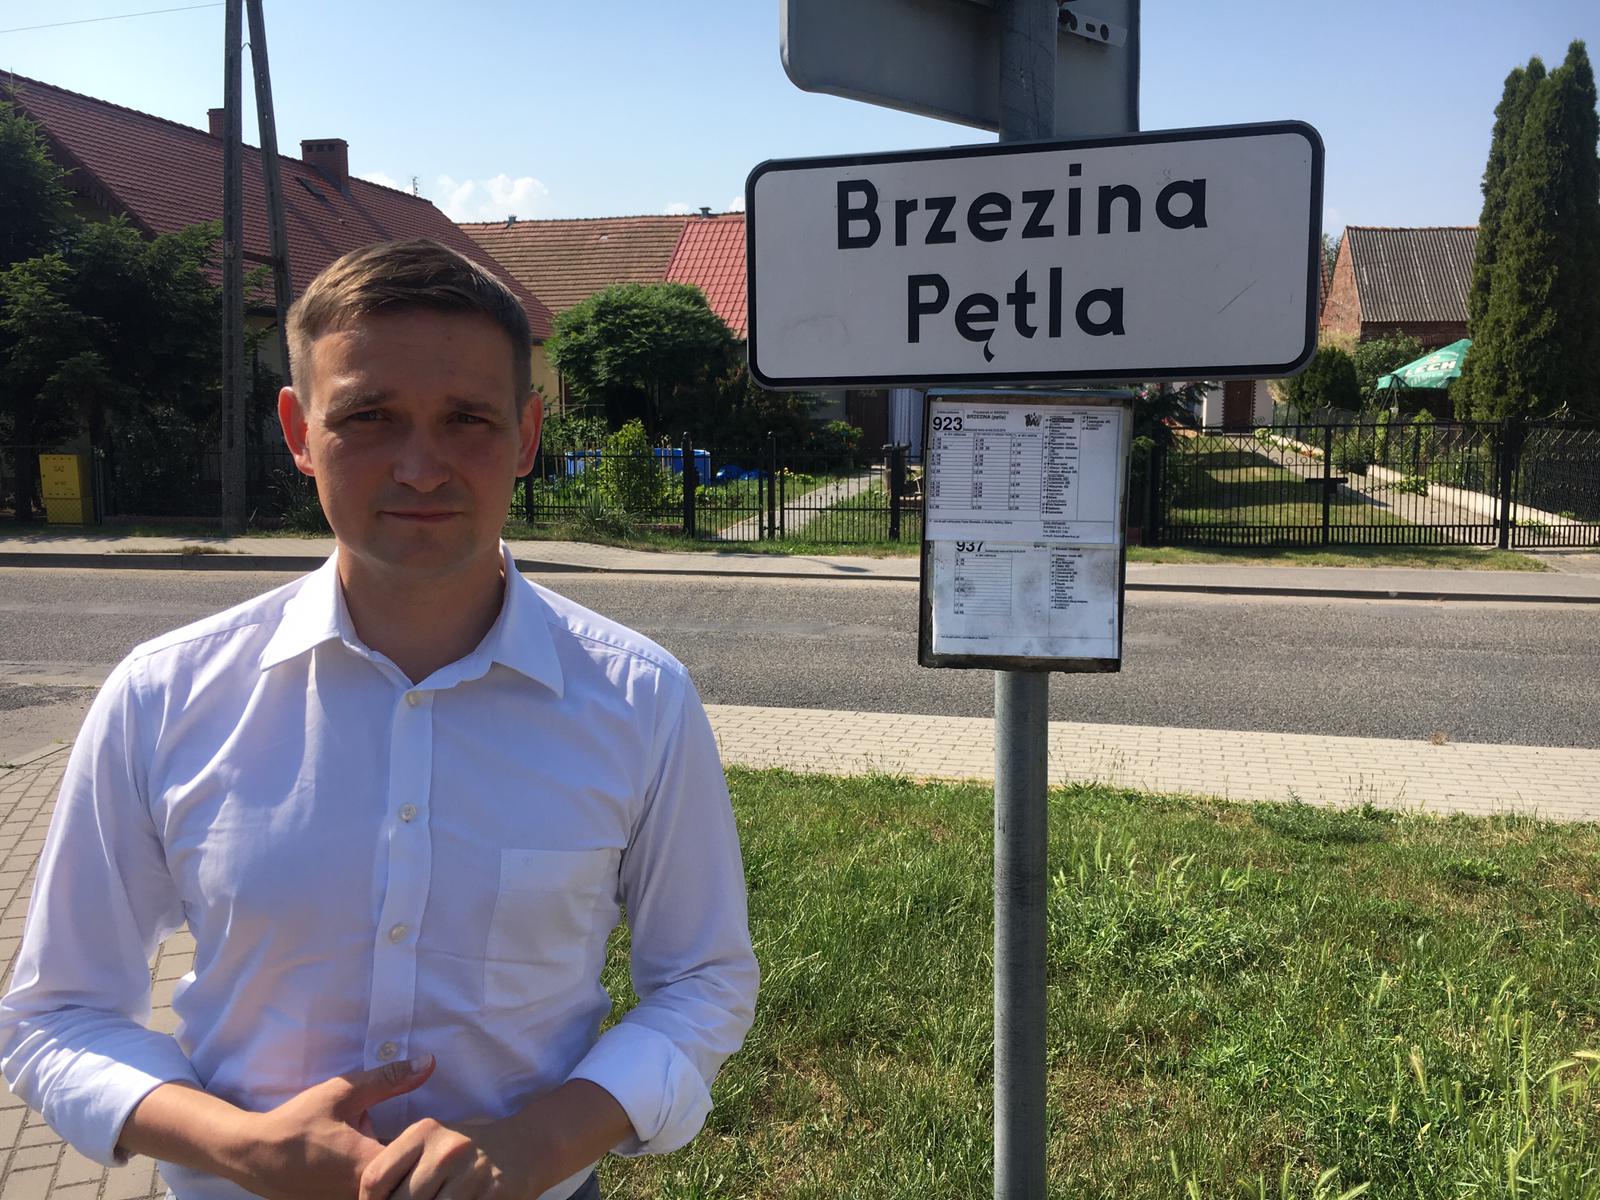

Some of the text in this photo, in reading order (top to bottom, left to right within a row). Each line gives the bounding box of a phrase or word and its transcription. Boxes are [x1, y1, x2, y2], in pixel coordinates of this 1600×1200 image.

[837, 163, 1208, 250] Brzezina
[907, 267, 1126, 363] Pętla
[1405, 360, 1457, 377] LECH
[932, 416, 963, 431] 923
[956, 541, 984, 552] 937
